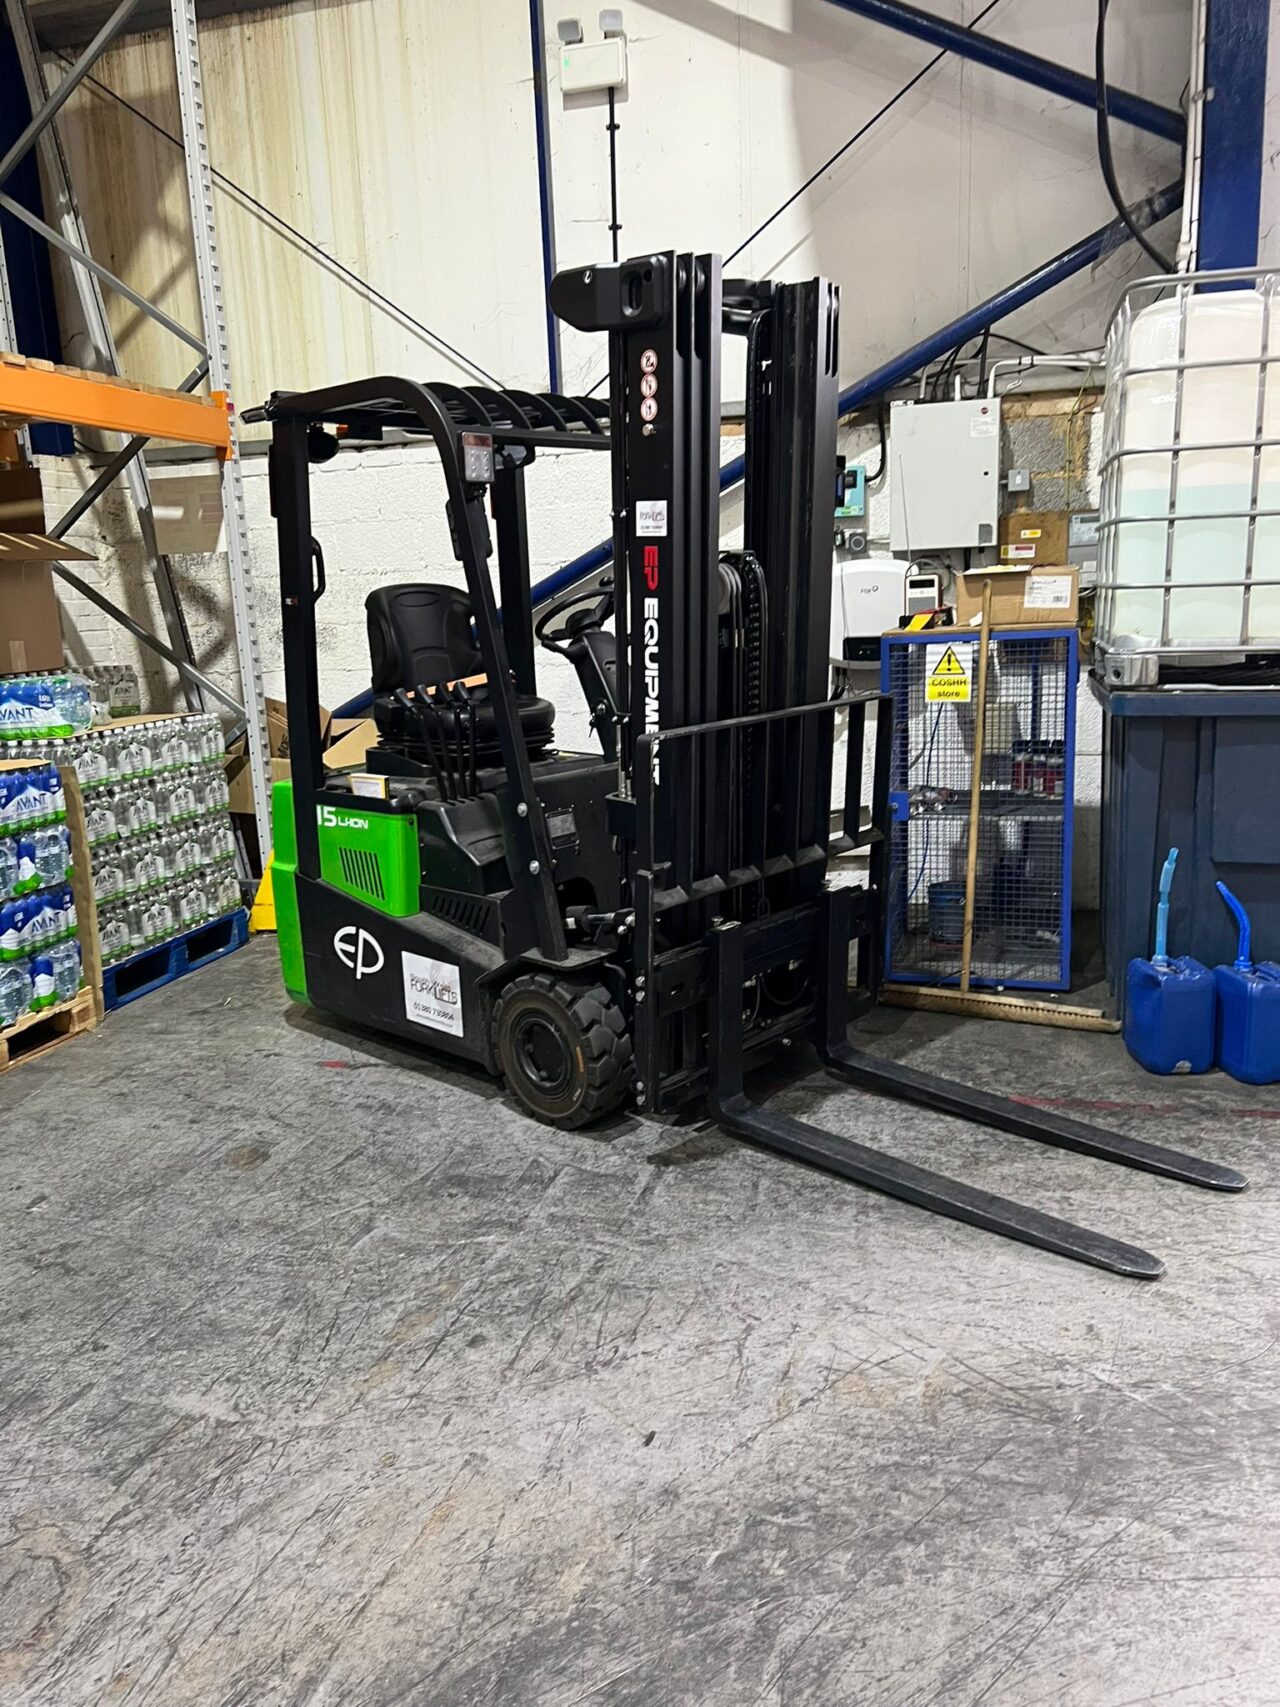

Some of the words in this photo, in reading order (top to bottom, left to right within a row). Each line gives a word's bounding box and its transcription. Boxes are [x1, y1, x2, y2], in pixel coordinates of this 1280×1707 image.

[643, 545, 659, 590] EP
[931, 678, 967, 687] COSHH
[937, 690, 961, 698] store
[16, 793, 47, 812] AVANT
